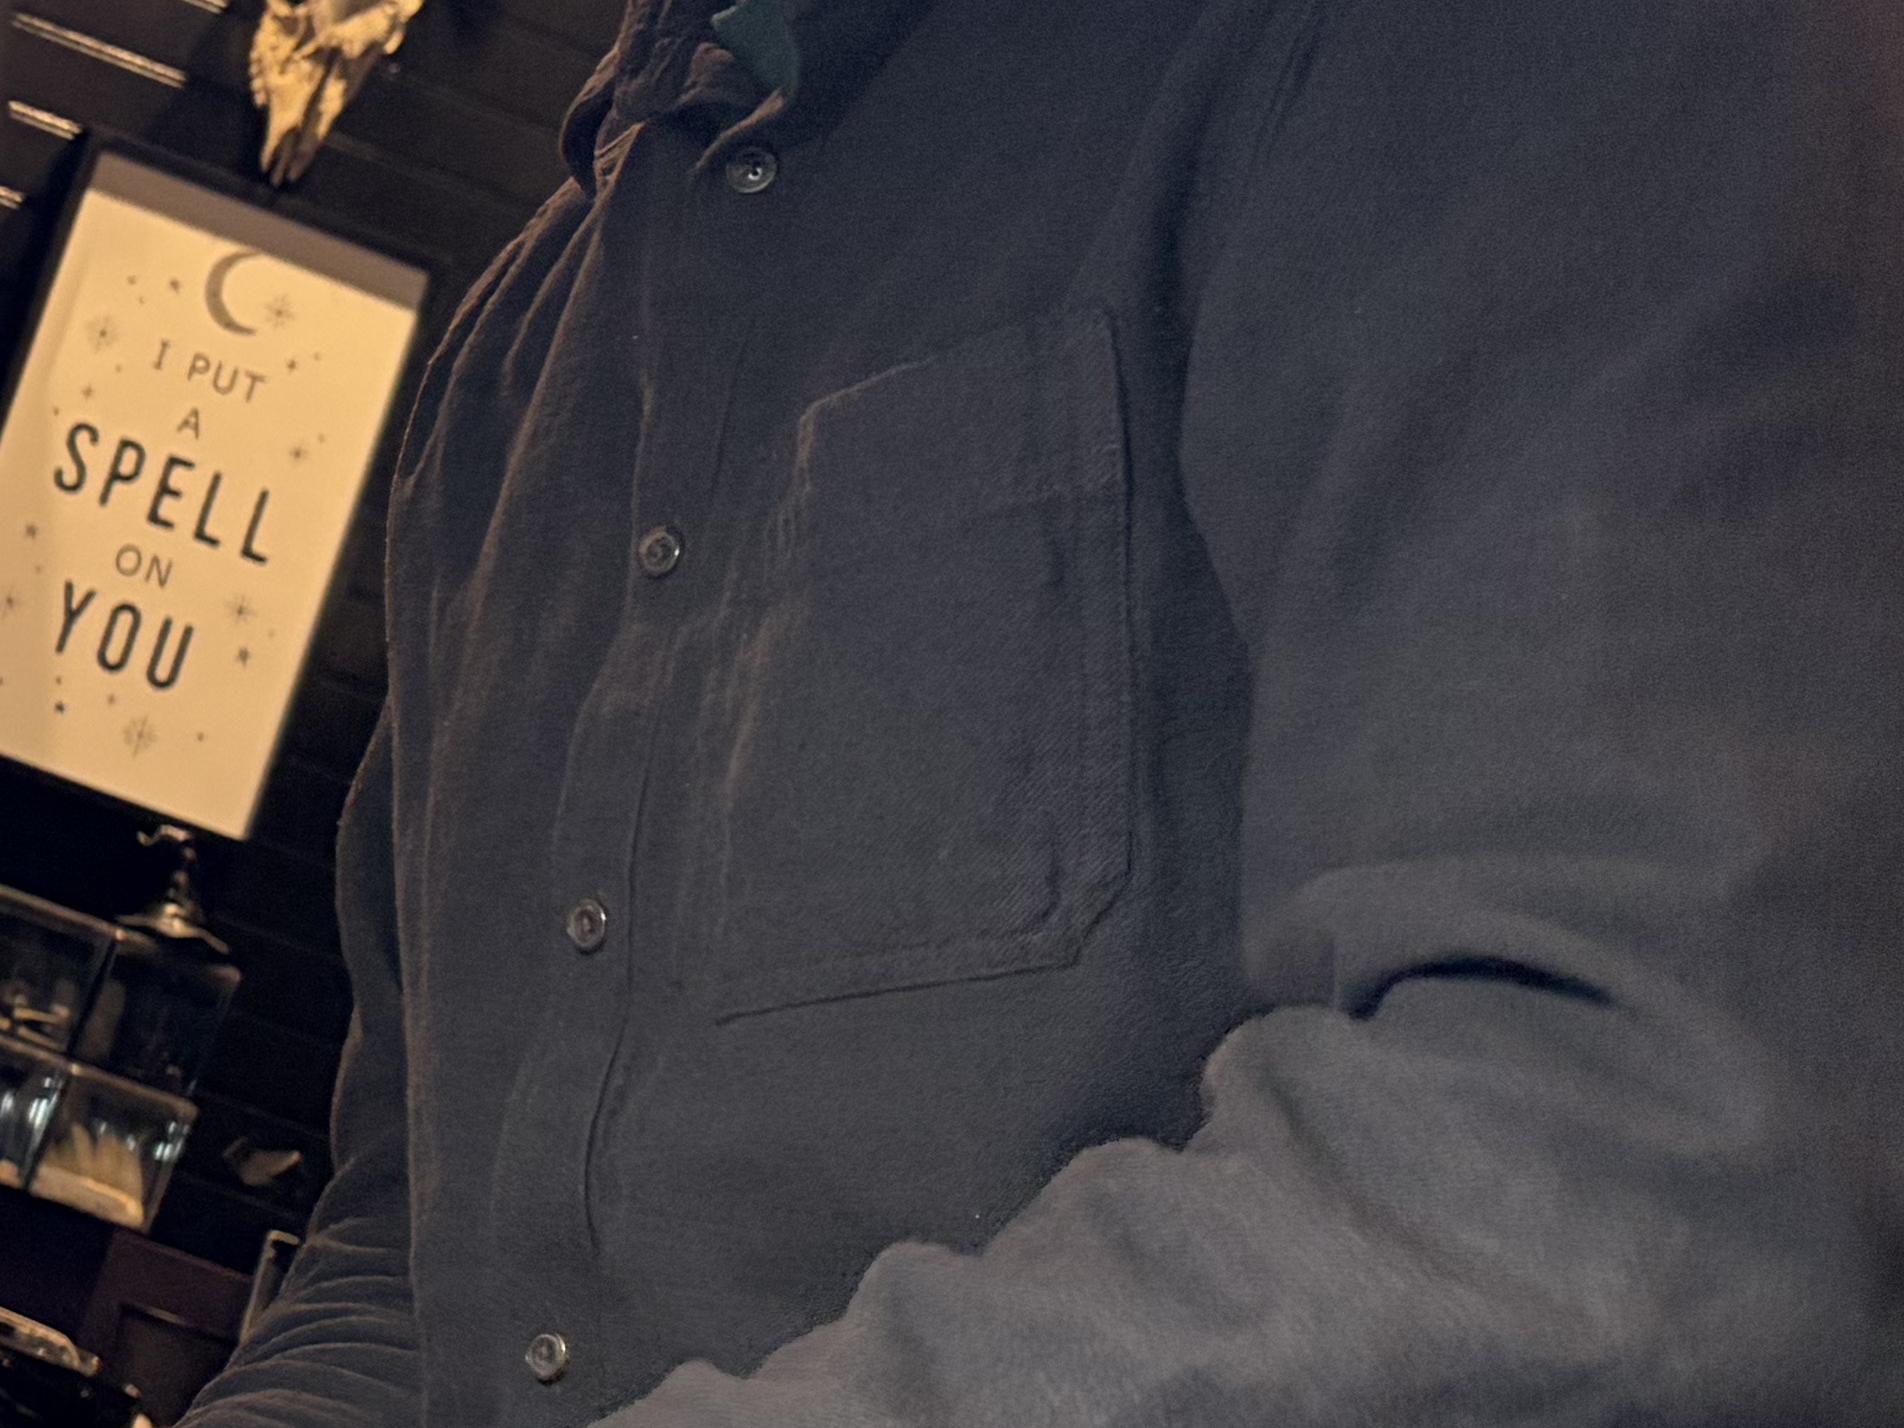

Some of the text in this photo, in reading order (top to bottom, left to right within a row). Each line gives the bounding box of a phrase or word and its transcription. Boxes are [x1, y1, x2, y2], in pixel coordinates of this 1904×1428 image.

[153, 338, 266, 403] I PUT
[177, 407, 200, 441] A
[53, 423, 269, 565] SPELL
[116, 544, 173, 588] ON
[56, 580, 193, 690] YOU
